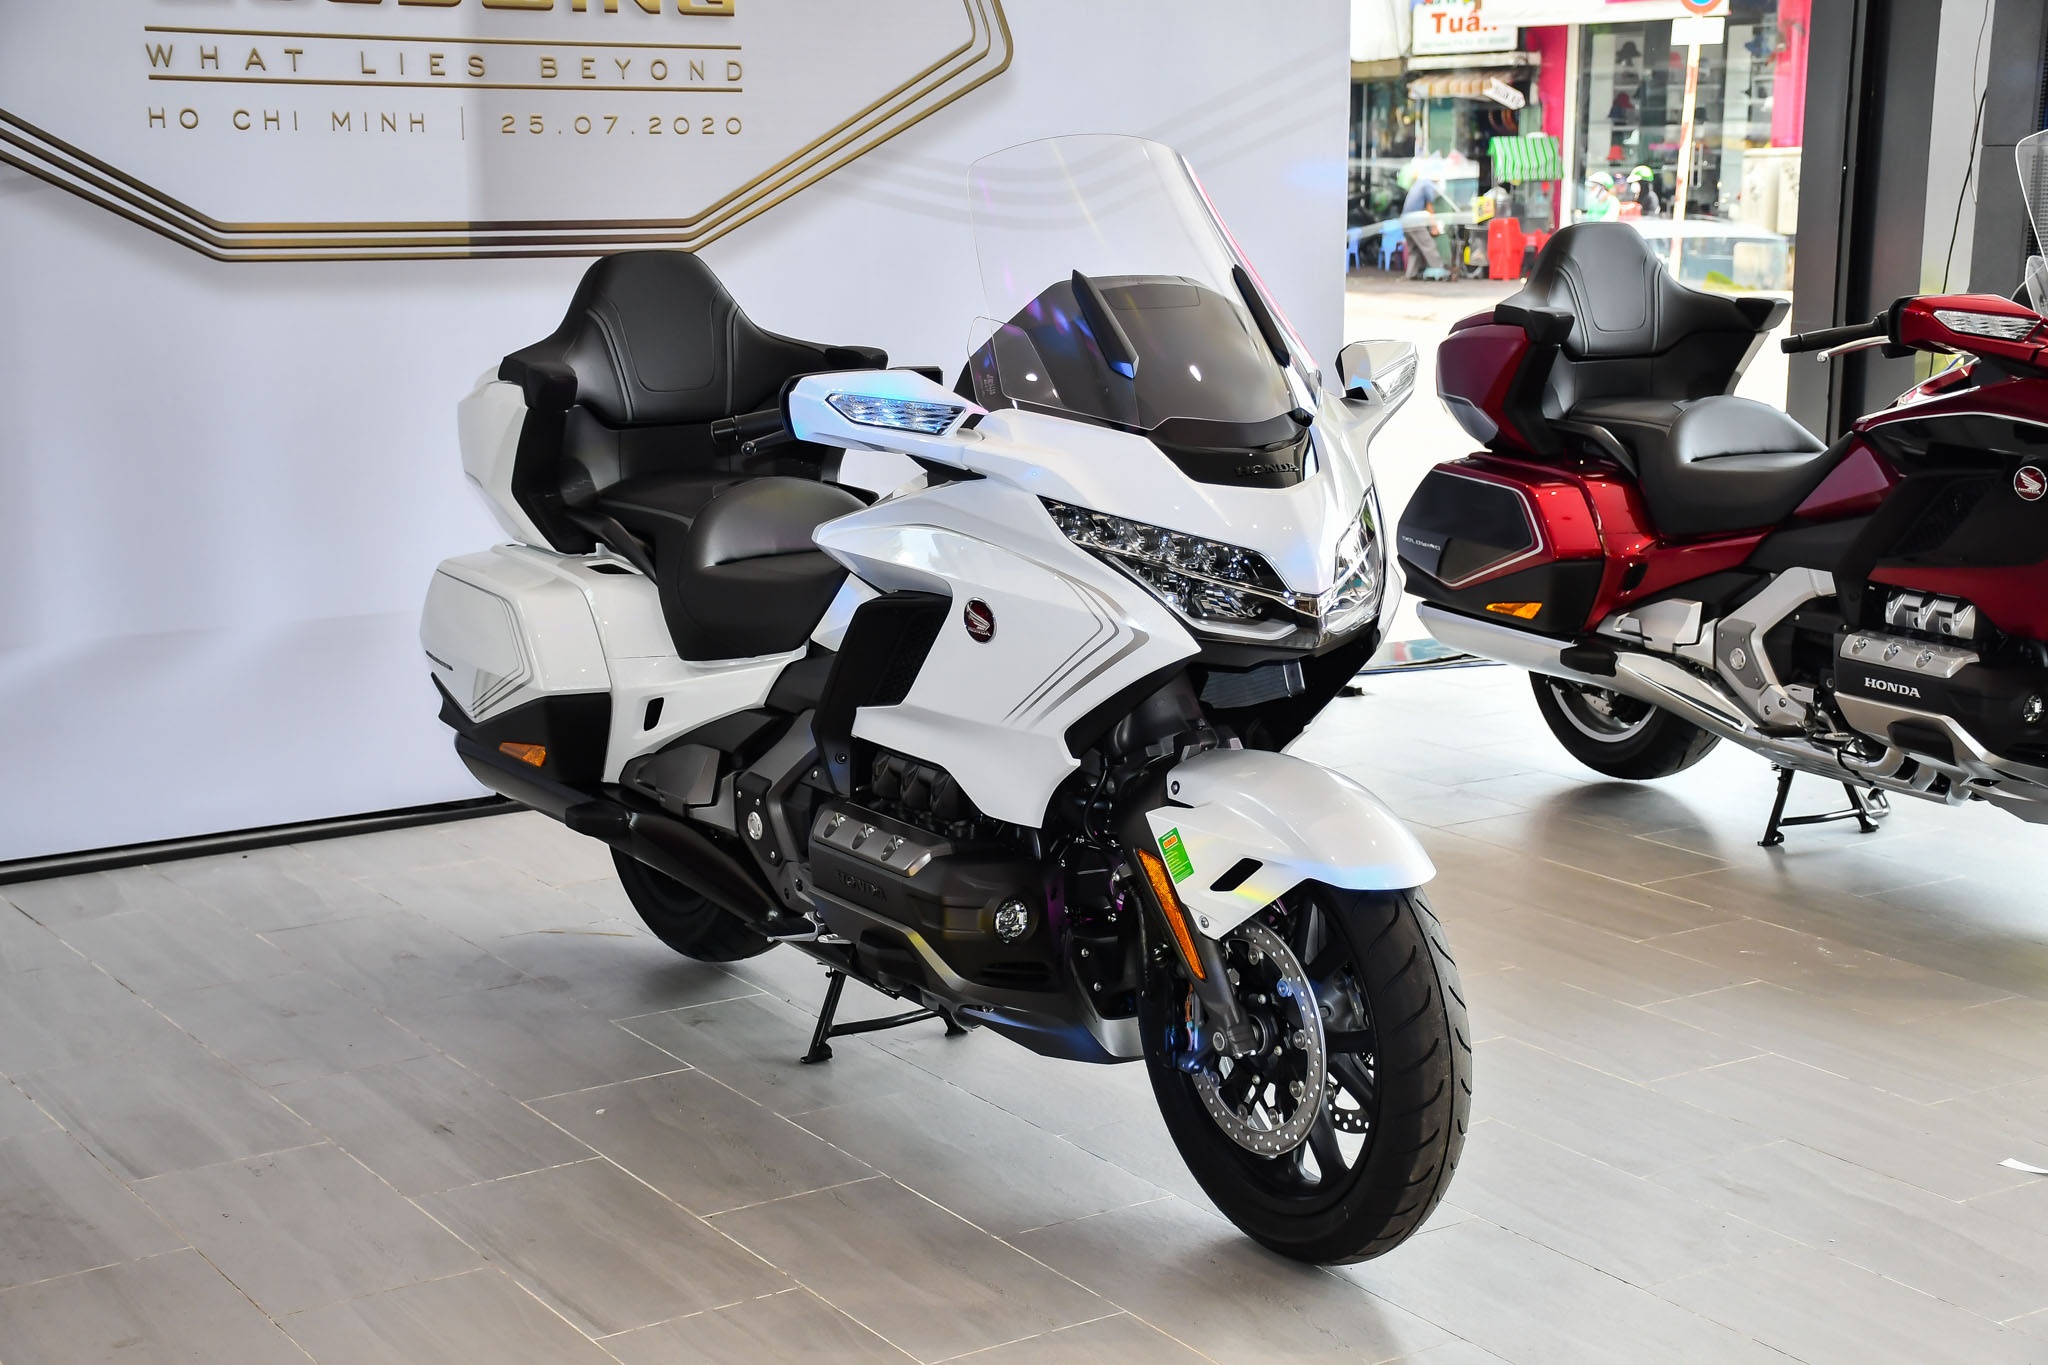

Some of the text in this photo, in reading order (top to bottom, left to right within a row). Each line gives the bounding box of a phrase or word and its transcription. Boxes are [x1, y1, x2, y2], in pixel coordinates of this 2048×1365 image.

[145, 43, 743, 82] WHAT LIES BEYOND
[148, 107, 743, 135] HO CHI MINH 25.07.2020
[1864, 677, 1921, 698] HONDA
